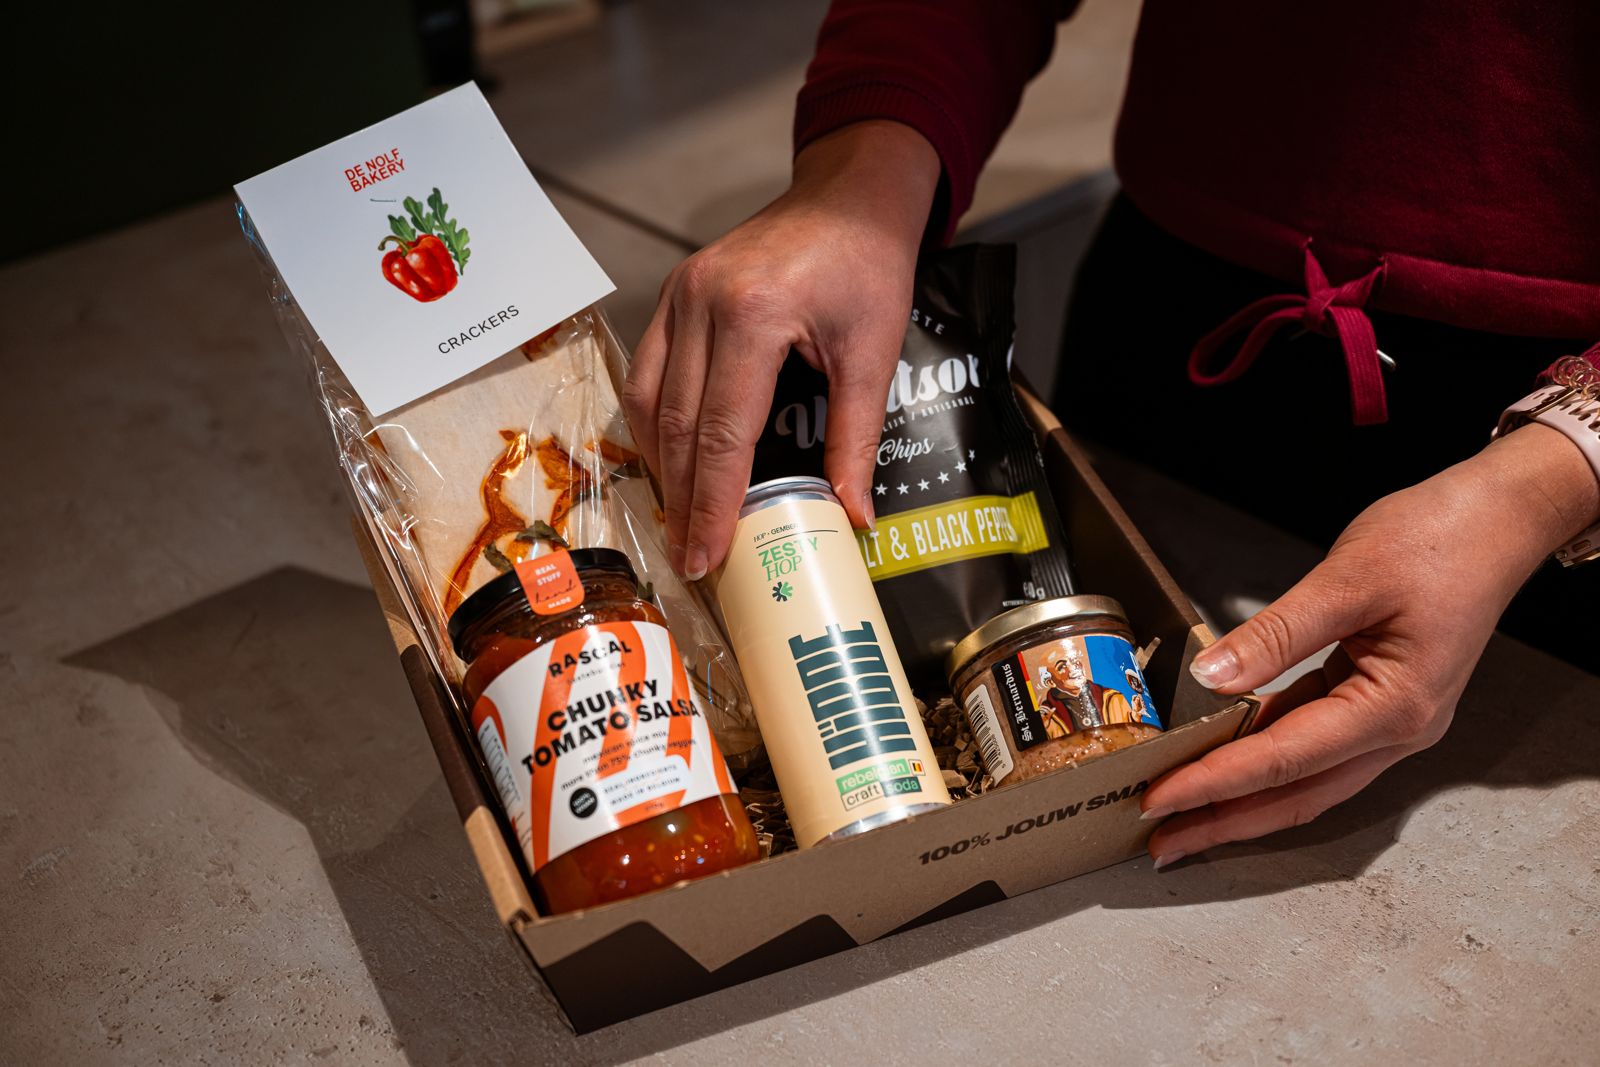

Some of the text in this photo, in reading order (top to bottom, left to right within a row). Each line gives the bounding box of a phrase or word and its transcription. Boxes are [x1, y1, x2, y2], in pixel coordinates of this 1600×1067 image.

[345, 148, 400, 181] DE NOLF
[350, 159, 407, 192] BAKERY
[438, 305, 519, 354] CRACKERS
[911, 309, 945, 335] STE
[882, 414, 907, 433] LIJK
[922, 396, 975, 419] ARTISANAL
[877, 436, 935, 466] Chips
[758, 537, 818, 567] ZESTY
[862, 531, 884, 568] LT
[889, 526, 910, 561] &
[912, 512, 975, 556] BLACK
[766, 555, 802, 581] HOP
[548, 640, 632, 678] RASCAL
[547, 679, 658, 731] CHUNKY
[1002, 663, 1034, 742] St. Bernardus
[521, 712, 629, 775] TOMATO
[639, 698, 701, 722] SALSA
[841, 761, 907, 790] rebelan
[846, 777, 919, 806] craft soda
[918, 779, 1150, 865] 100% JOUW SMA
